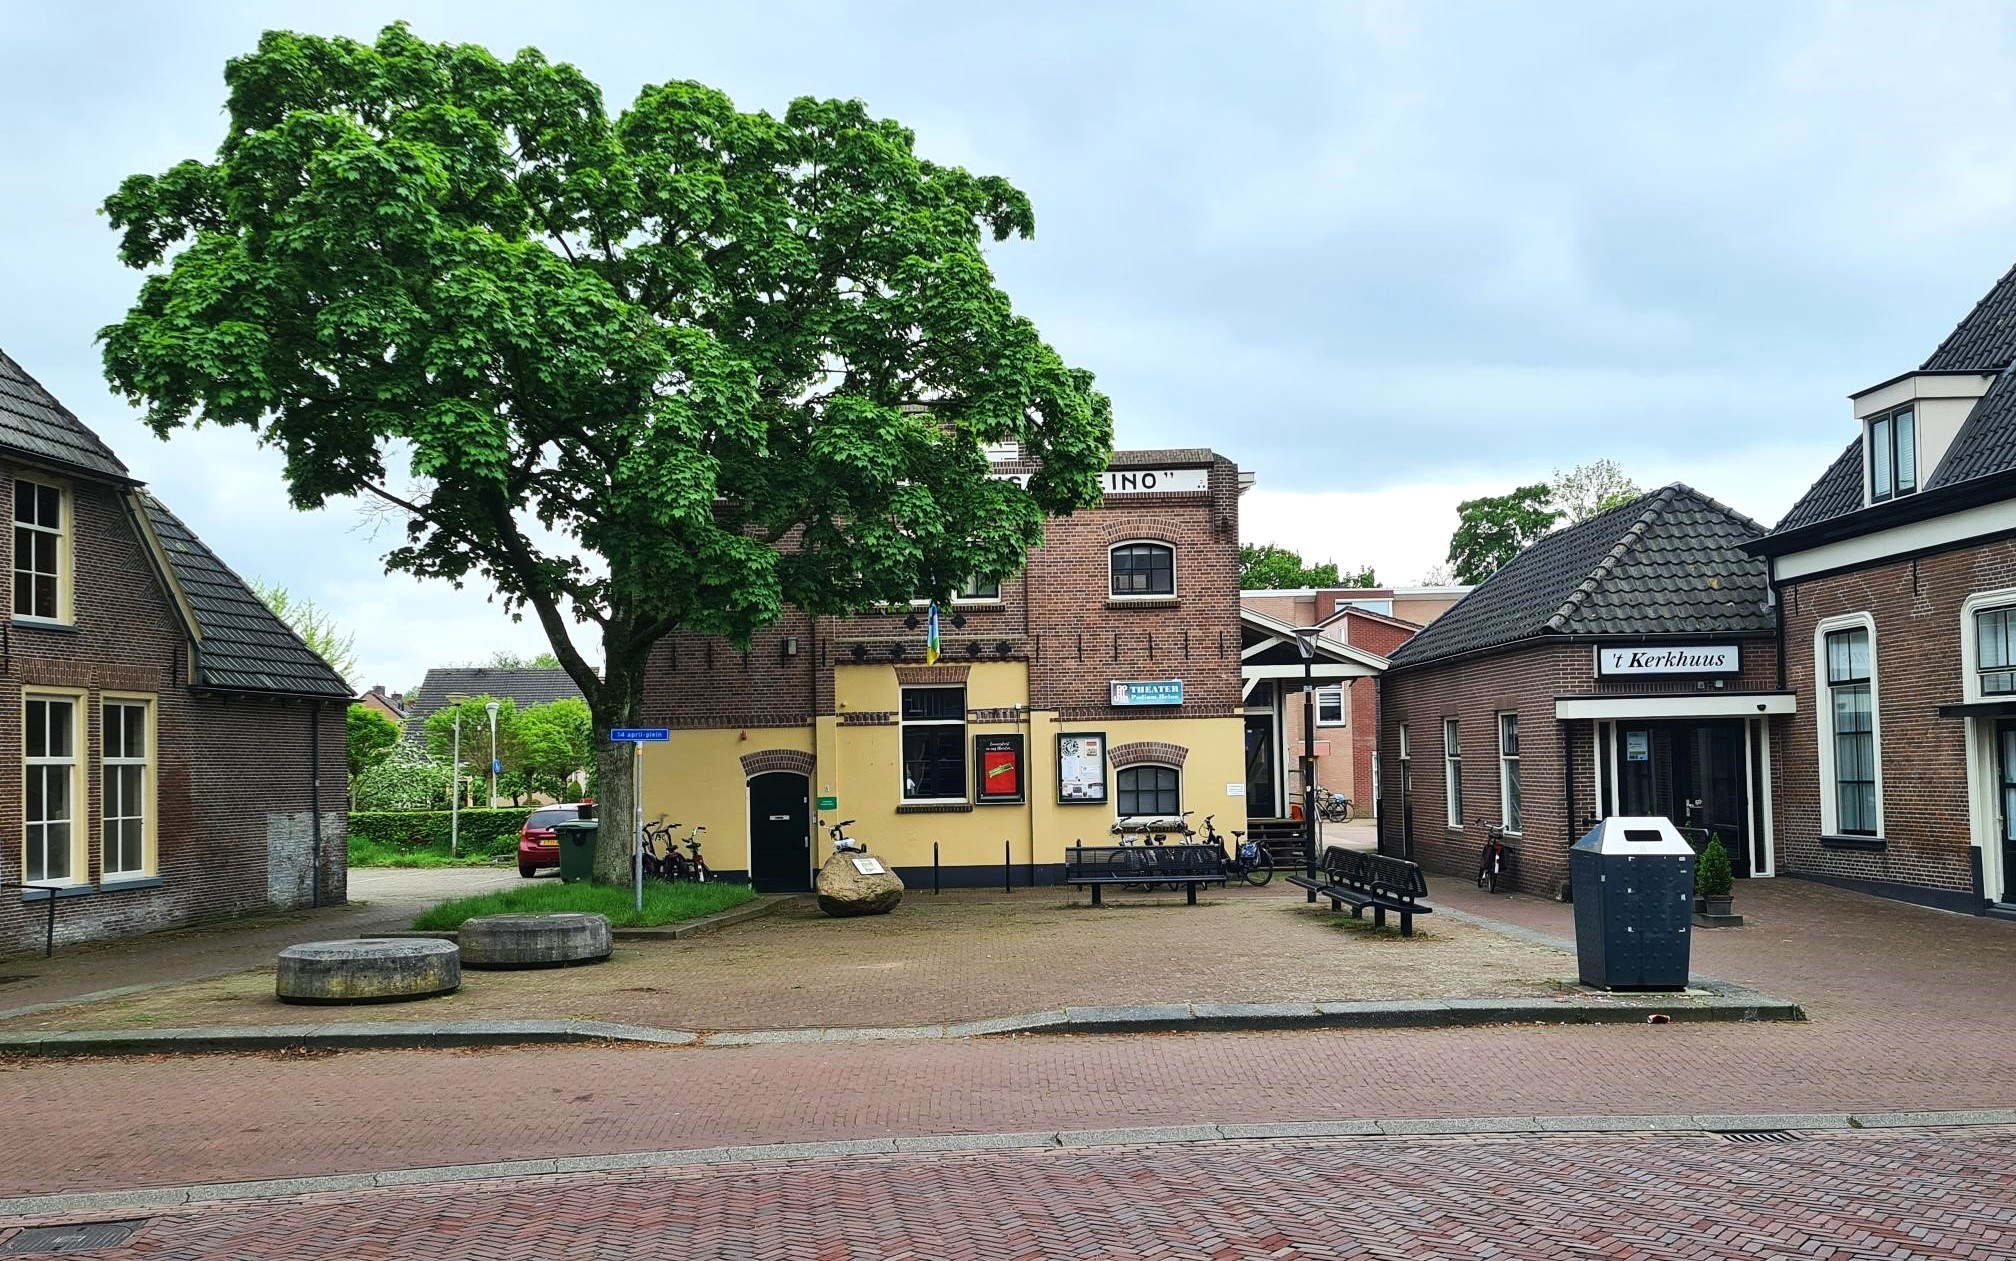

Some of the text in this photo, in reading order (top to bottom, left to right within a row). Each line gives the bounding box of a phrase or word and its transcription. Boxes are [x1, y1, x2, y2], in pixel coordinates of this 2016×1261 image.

[1613, 650, 1726, 669] 't Kerkhuus
[1130, 685, 1179, 693] THEATER
